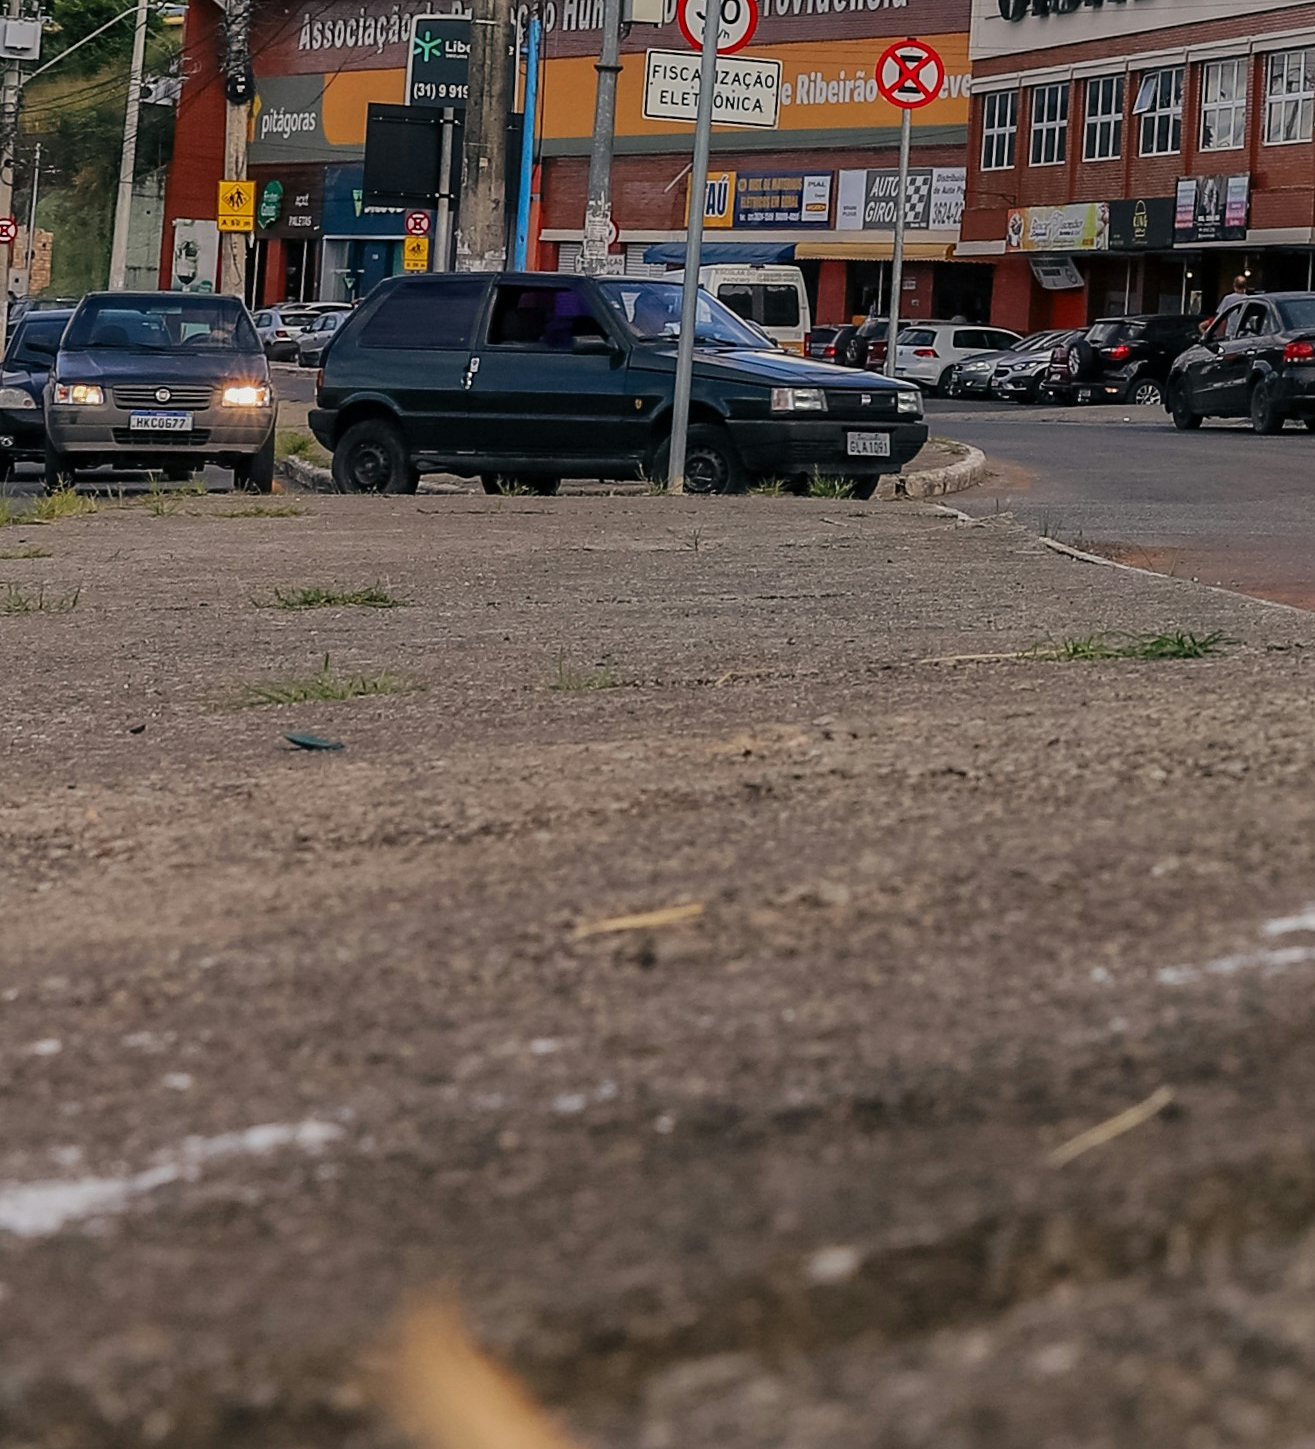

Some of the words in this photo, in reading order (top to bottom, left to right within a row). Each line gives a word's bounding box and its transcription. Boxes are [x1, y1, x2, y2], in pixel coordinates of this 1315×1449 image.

[297, 3, 411, 55] Associação
[413, 81, 436, 100] (31)
[652, 64, 776, 91] FISCAIZAÇÃO
[796, 70, 877, 106] Ribeirão
[659, 90, 764, 114] ELETÔNICA
[260, 106, 317, 140] pitágoras
[705, 174, 728, 217] AÚ
